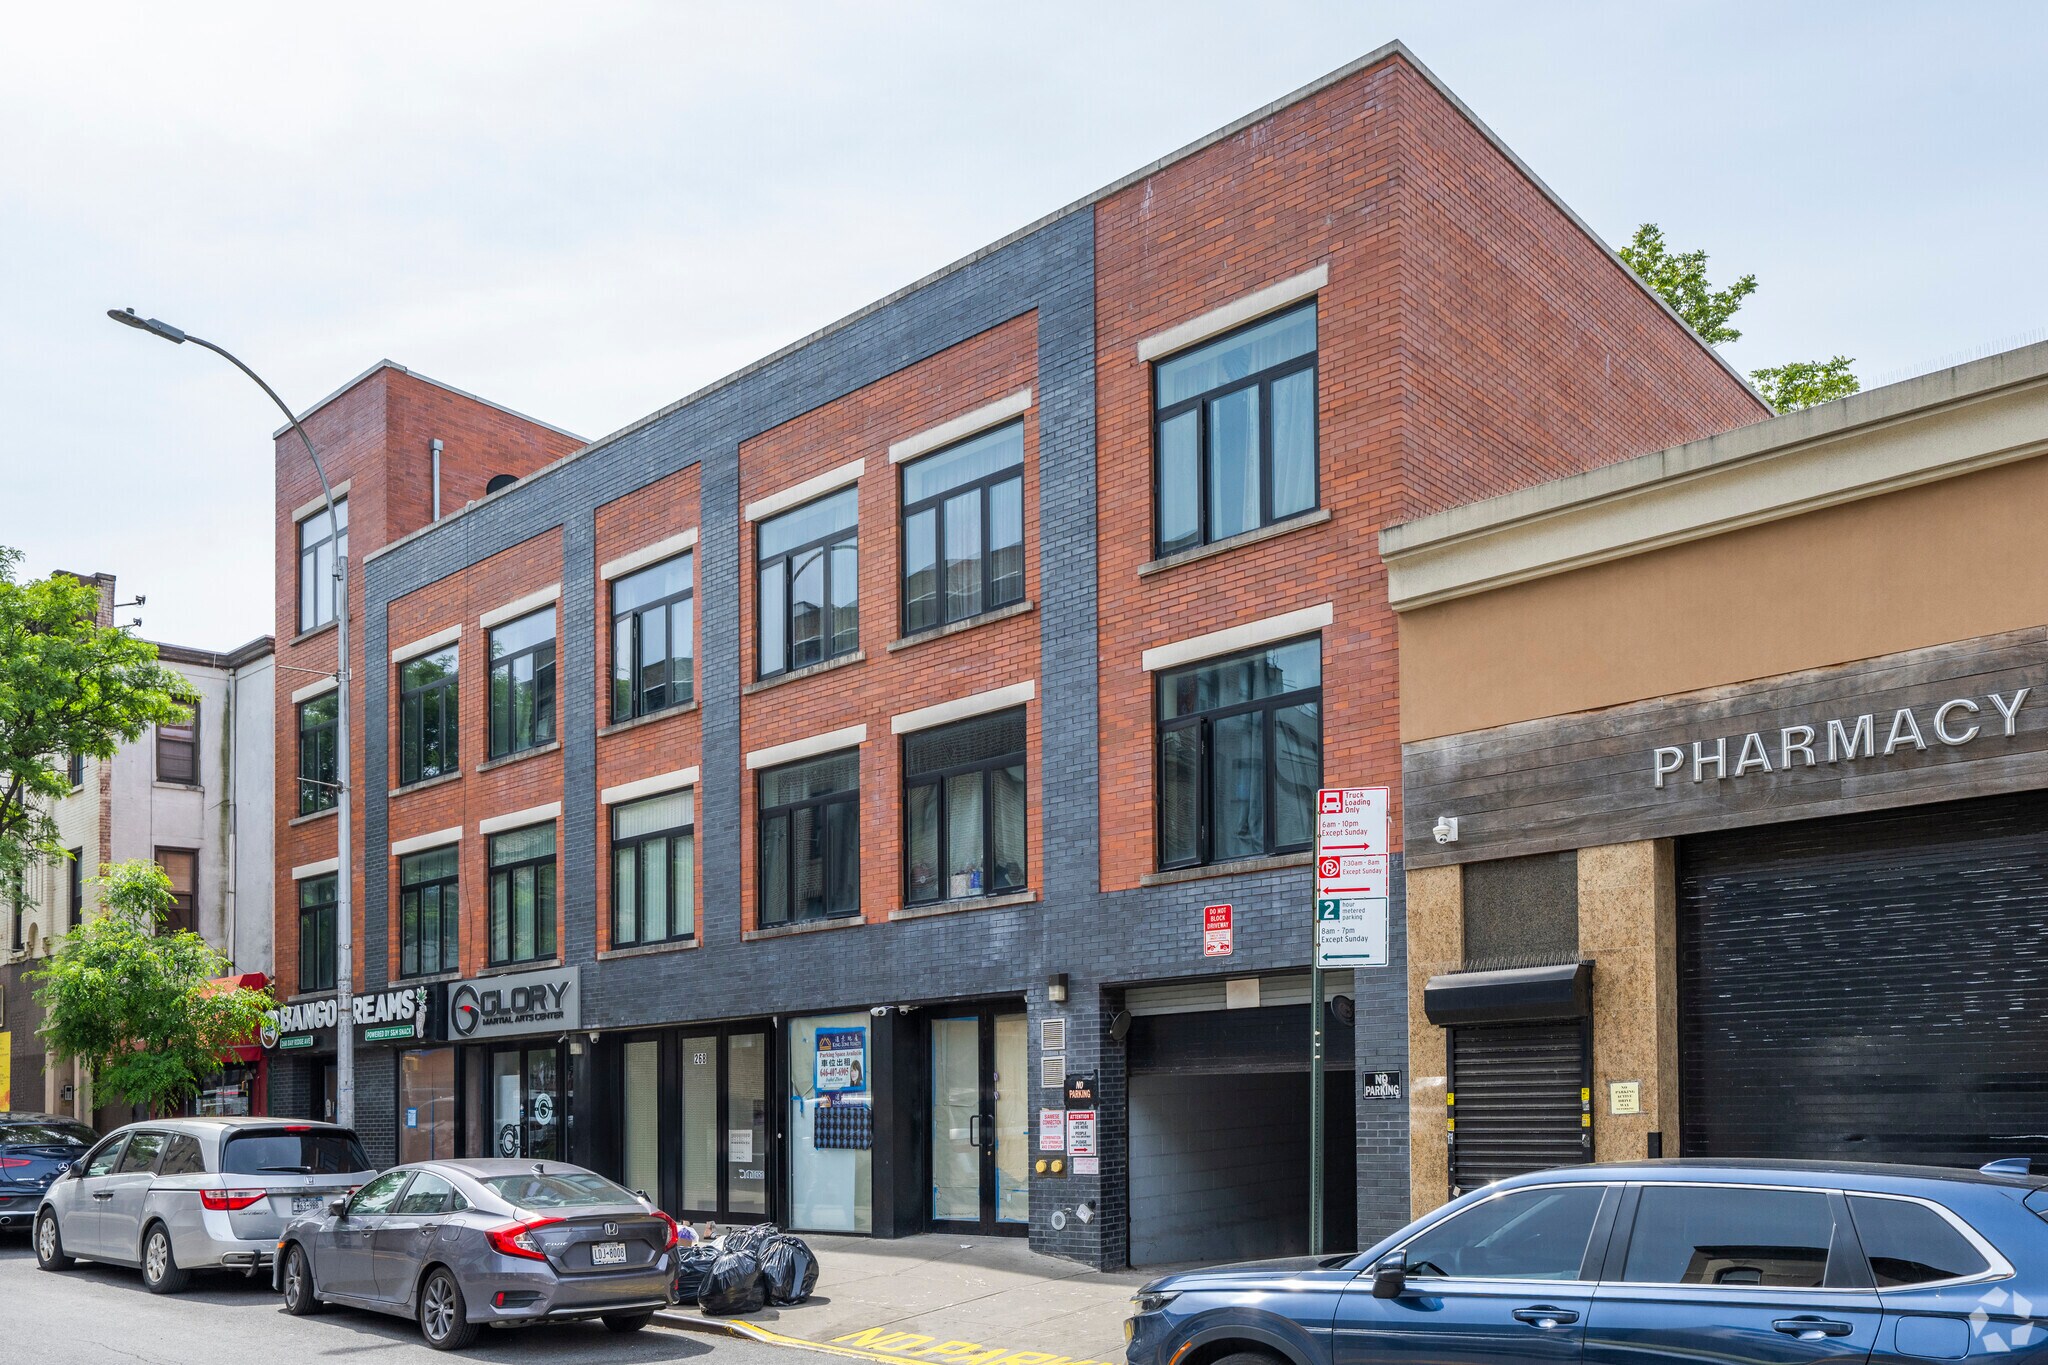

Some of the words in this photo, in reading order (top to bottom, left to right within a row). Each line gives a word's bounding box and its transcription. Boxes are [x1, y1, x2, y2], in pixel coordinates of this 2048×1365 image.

[1653, 687, 2031, 789] PHARMACY
[1342, 821, 1359, 829] 10pm
[1344, 829, 1368, 837] Sunday
[1324, 901, 1335, 918] 2
[1342, 927, 1355, 935] 7pm
[1344, 935, 1368, 943] Sunday
[480, 982, 572, 1017] GLORY
[280, 999, 337, 1033] BANGO
[353, 989, 416, 1025] REAMS
[483, 1016, 513, 1026] MARTIAL
[514, 1014, 534, 1022] ARTS
[535, 1011, 564, 1021] CENTER
[821, 1058, 850, 1067] 車位出租
[1375, 1074, 1388, 1084] NO
[1076, 1081, 1084, 1089] NO
[1069, 1089, 1091, 1098] PARKING
[1365, 1085, 1399, 1096] PARKING
[832, 1328, 936, 1351] NO
